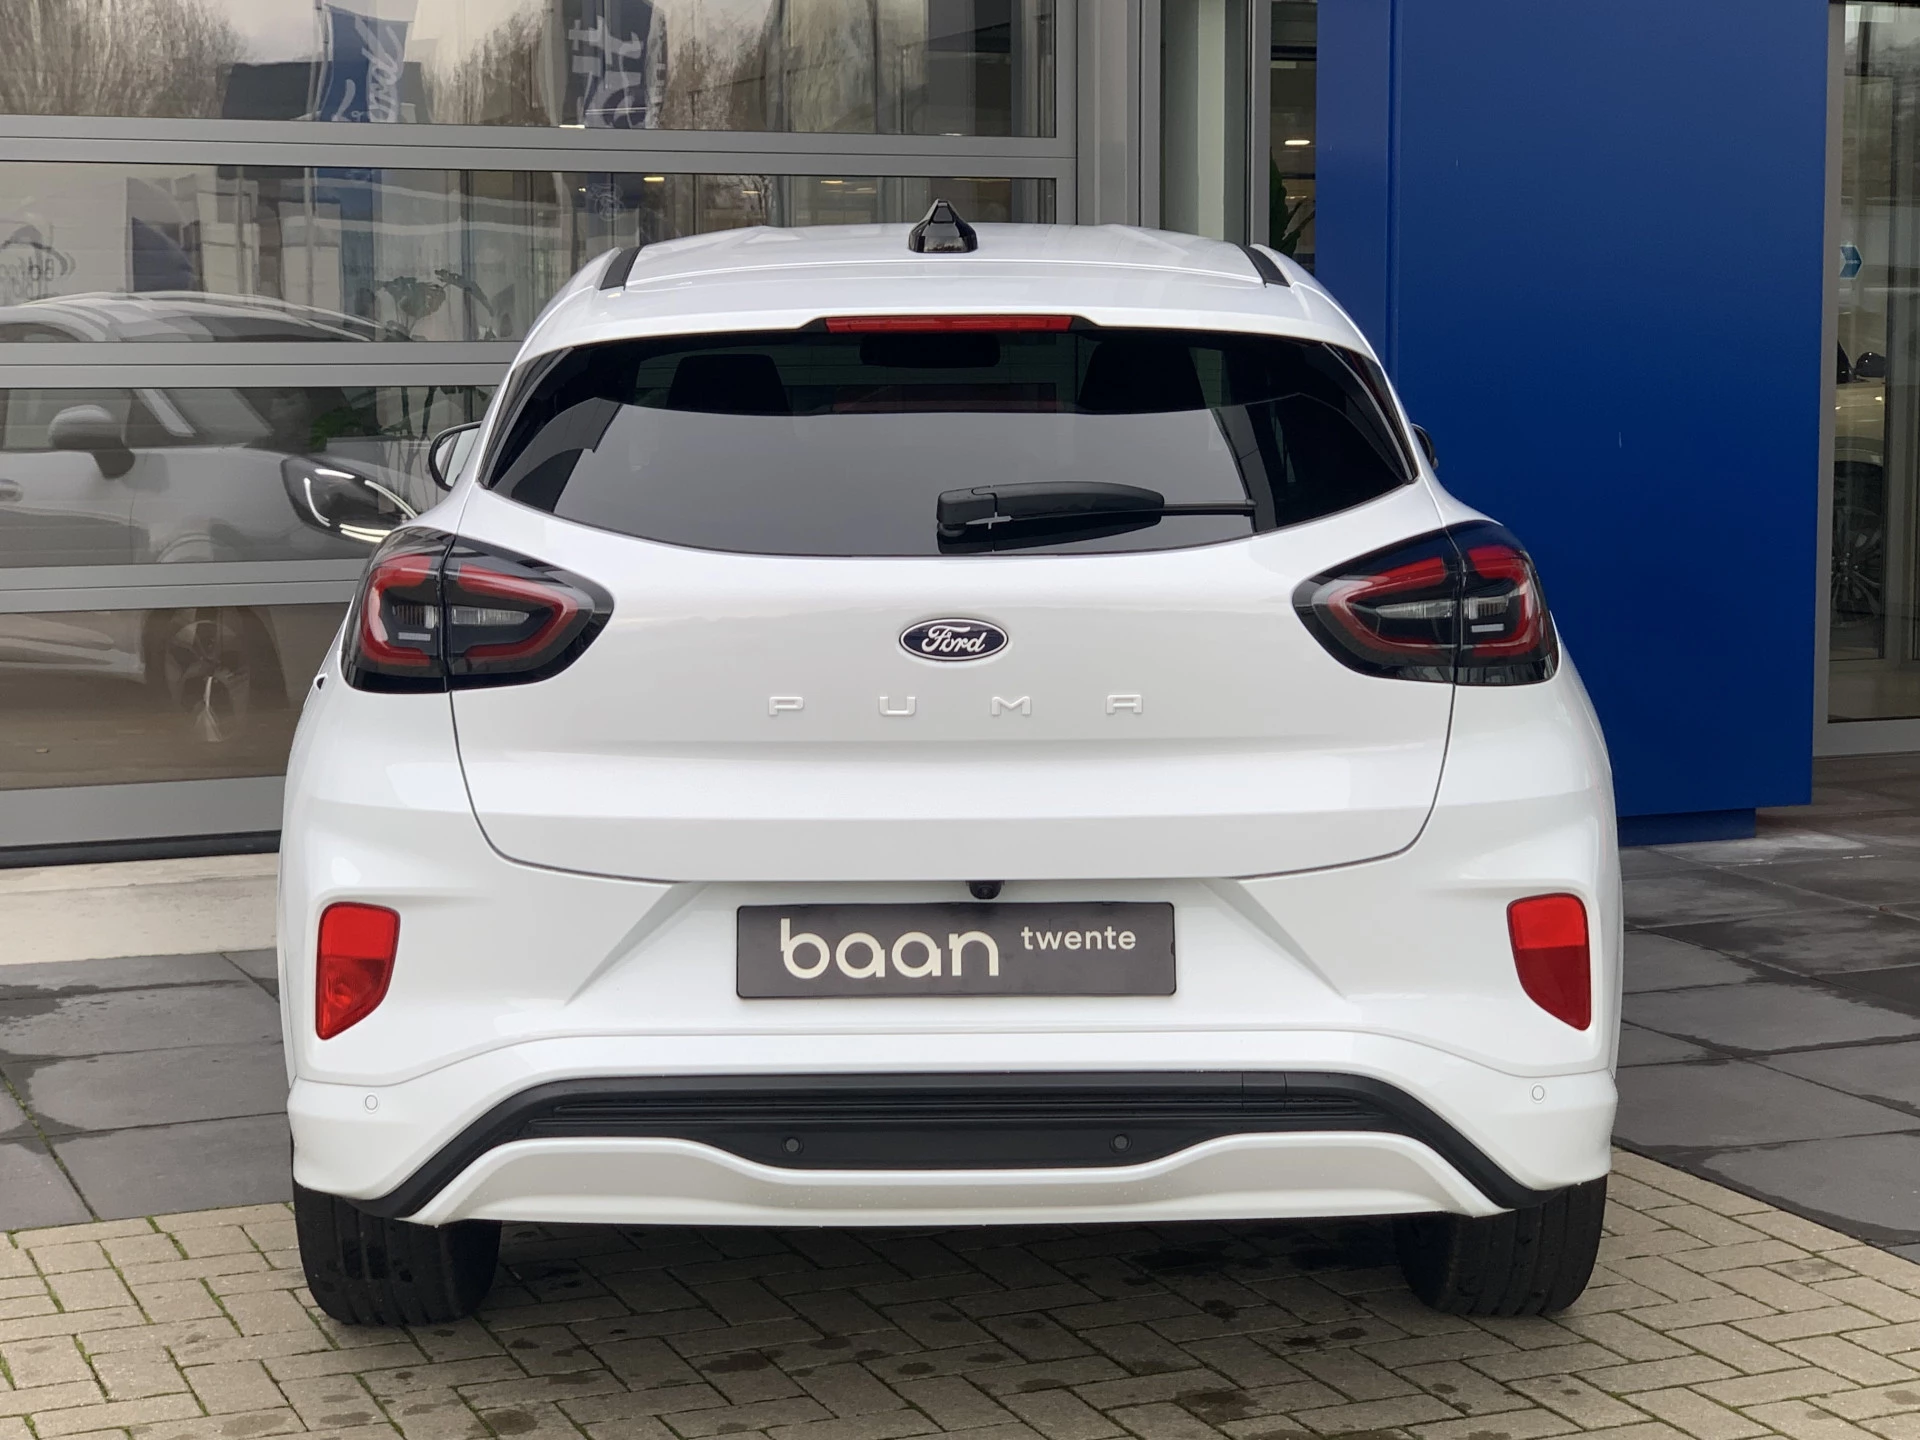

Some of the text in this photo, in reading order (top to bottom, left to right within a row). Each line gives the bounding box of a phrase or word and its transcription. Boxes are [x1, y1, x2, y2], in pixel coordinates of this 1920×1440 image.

[921, 625, 987, 653] Ford
[768, 694, 1143, 716] PUMA
[780, 918, 1137, 979] baan twente
